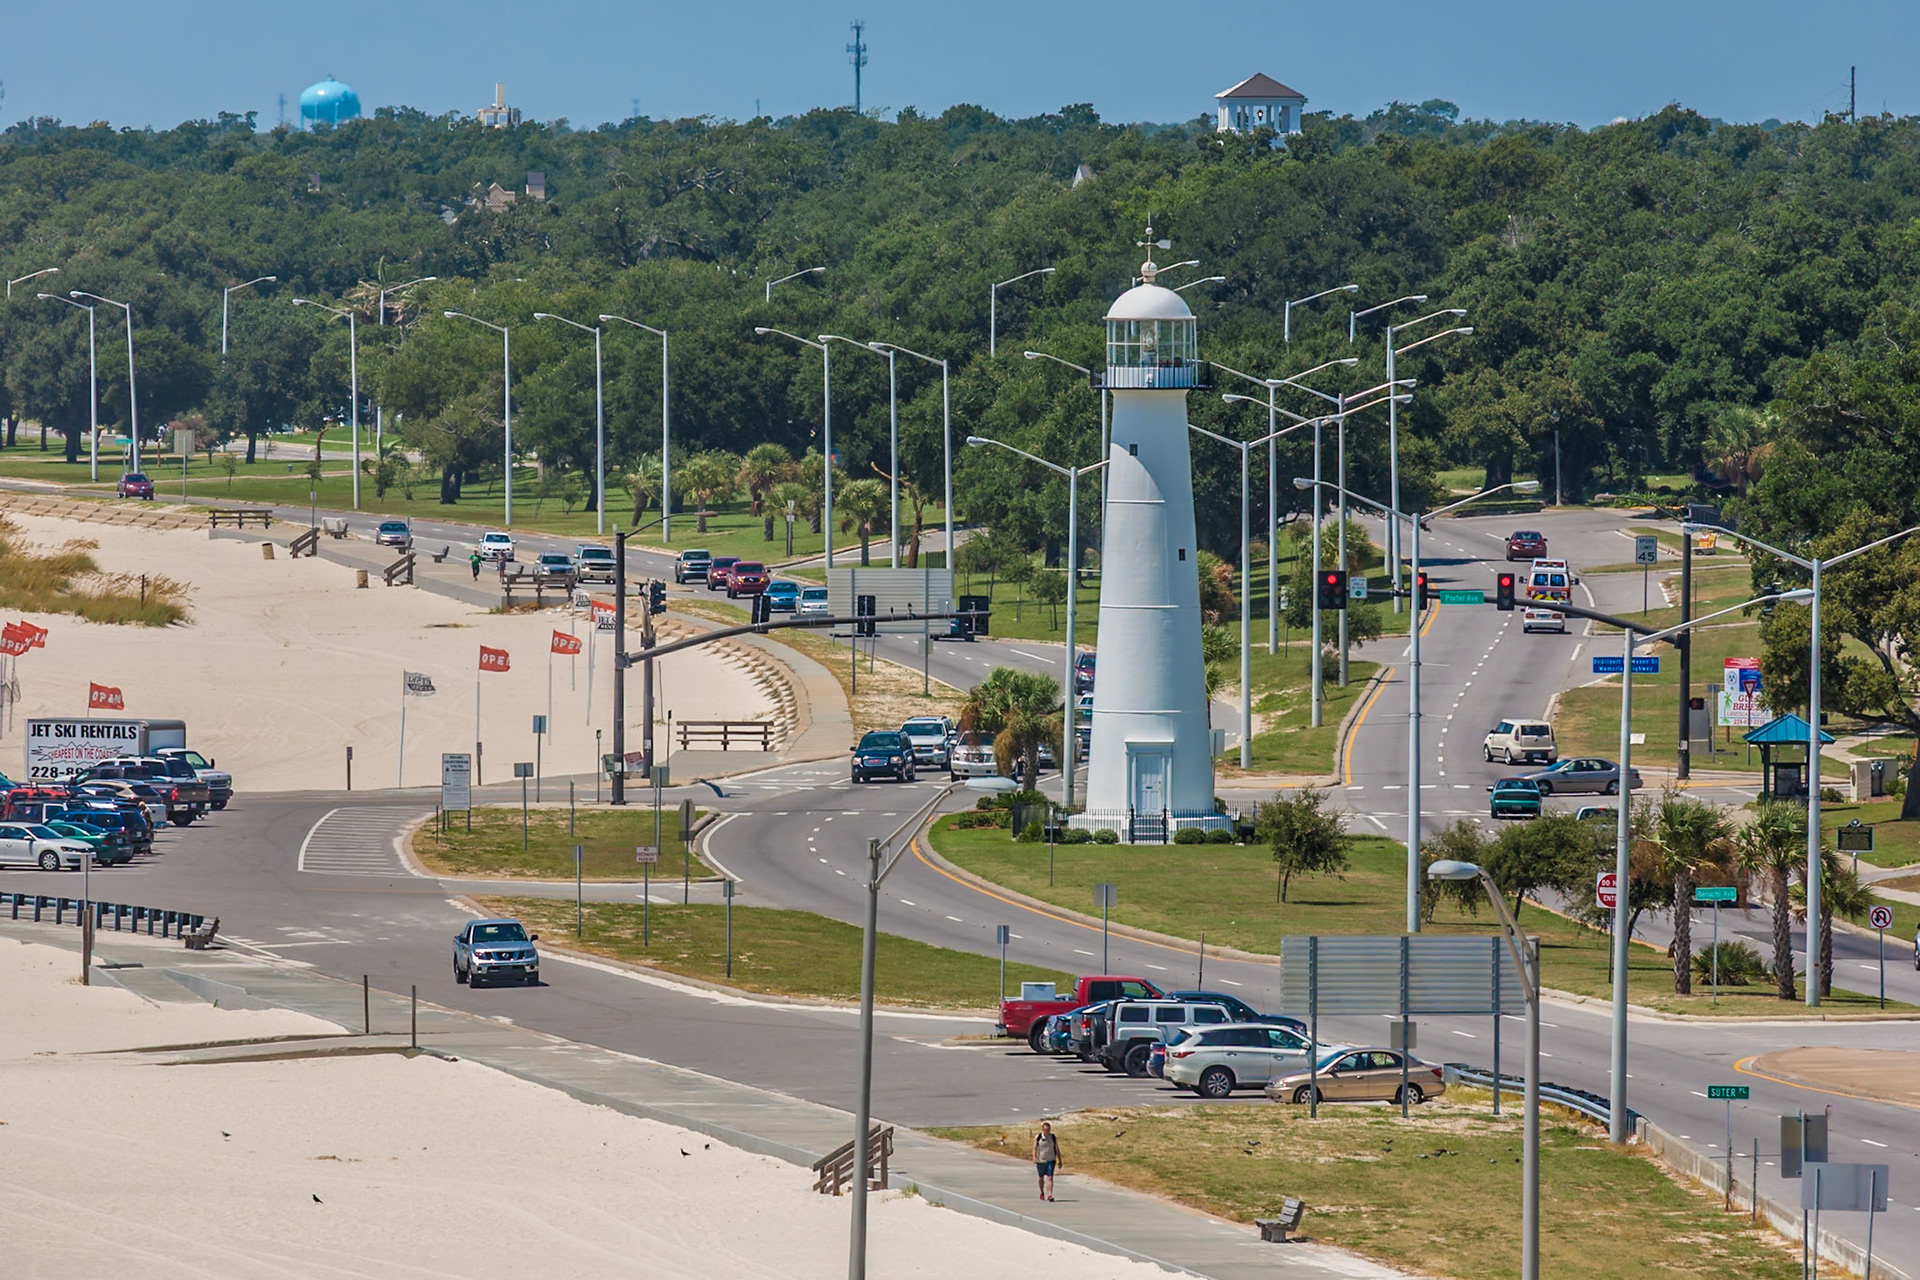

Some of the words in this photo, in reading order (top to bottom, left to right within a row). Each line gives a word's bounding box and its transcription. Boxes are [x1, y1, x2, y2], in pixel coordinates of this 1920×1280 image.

[1638, 551, 1655, 561] 45
[31, 724, 51, 737] JET
[55, 724, 76, 738] SKI
[80, 724, 137, 740] RENTALS
[74, 747, 83, 759] ON
[84, 747, 94, 759] THE
[1711, 1087, 1737, 1097] SUTER
